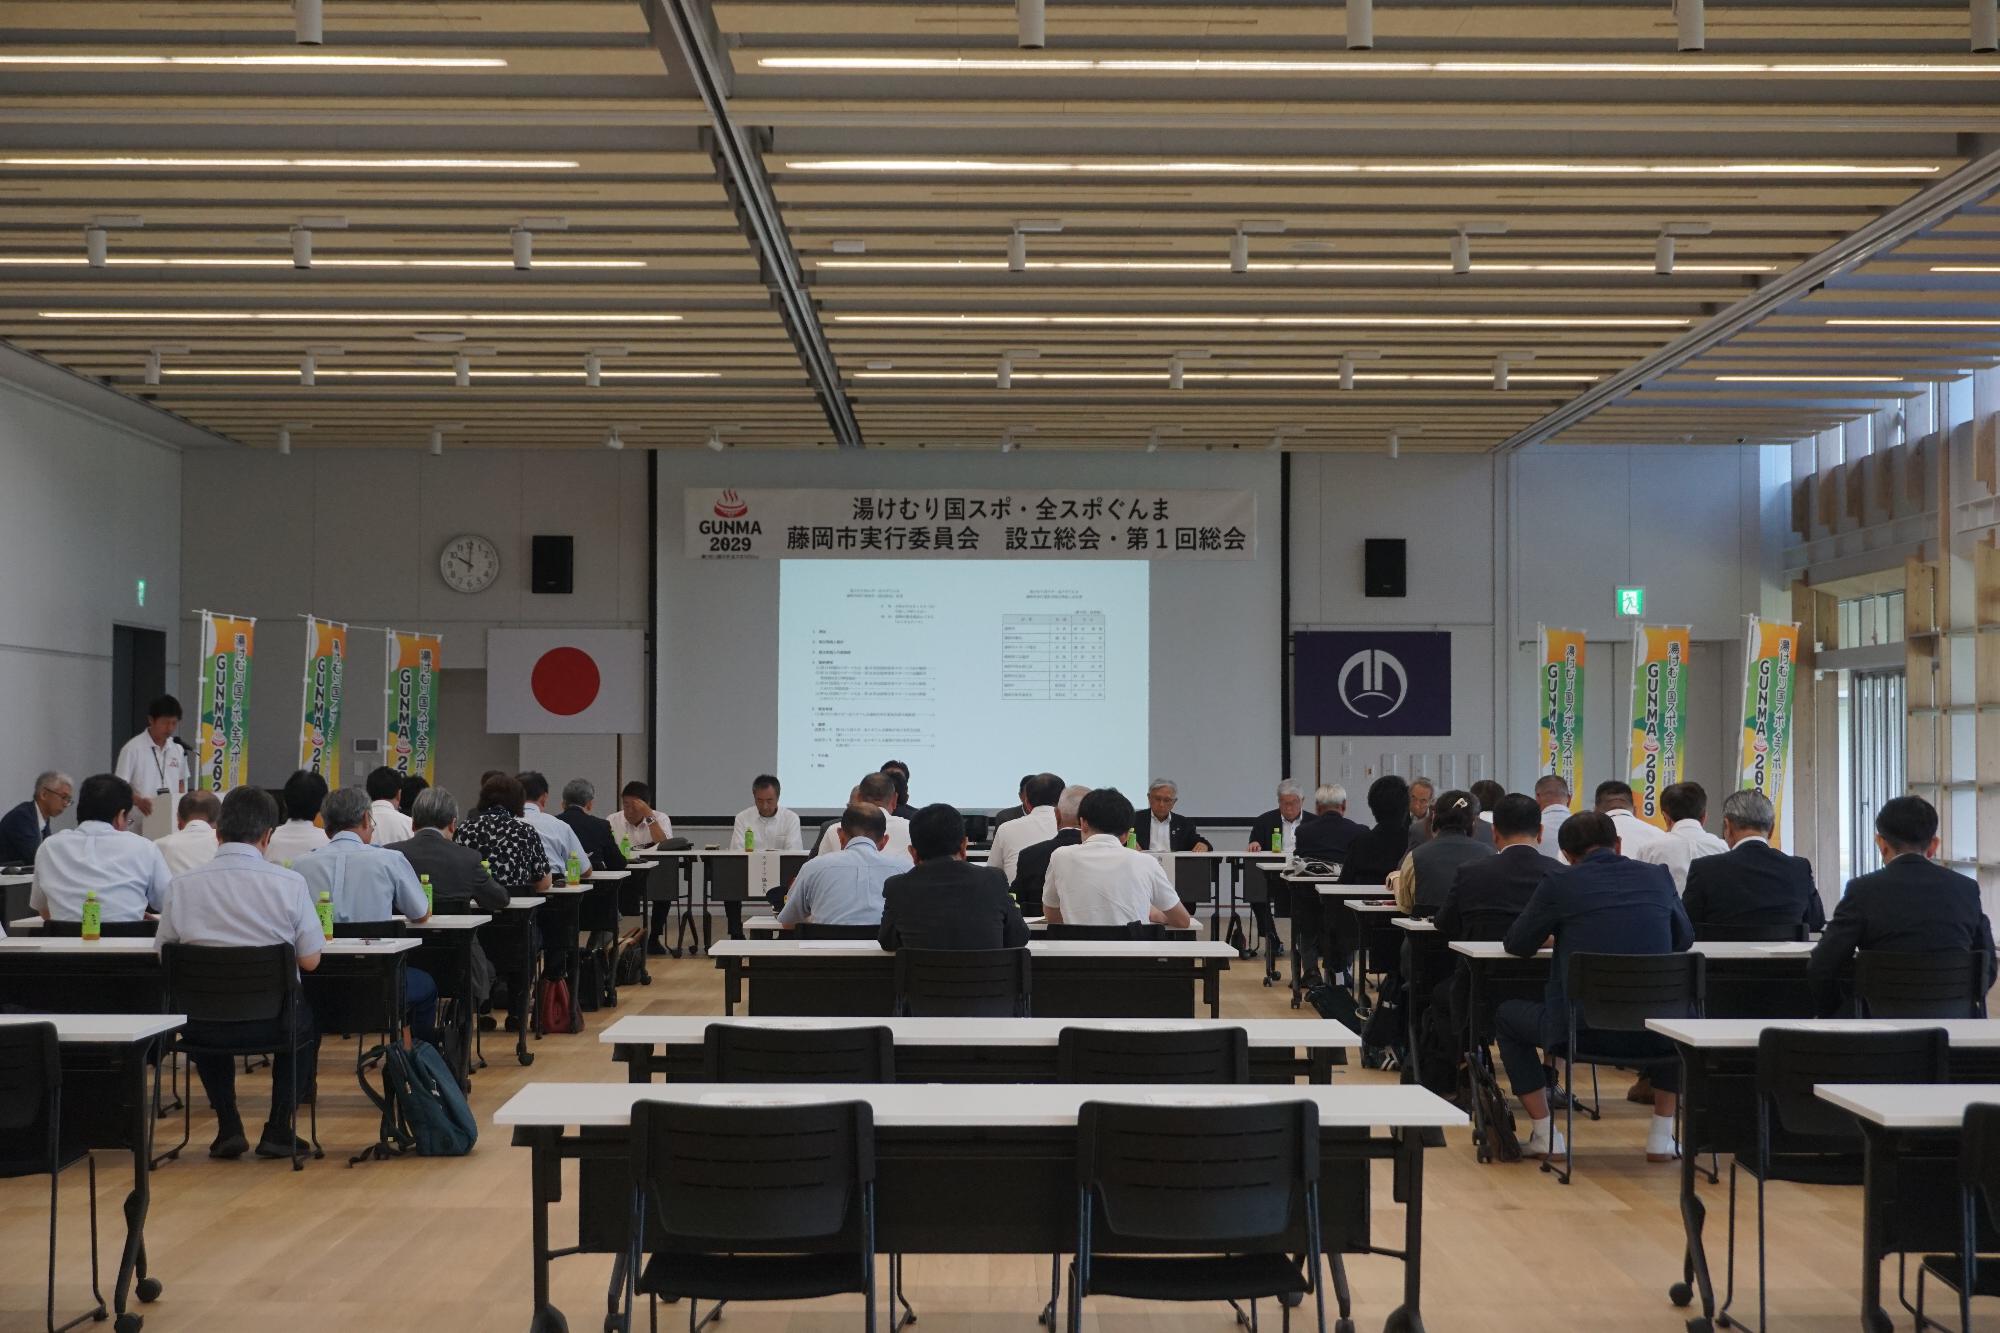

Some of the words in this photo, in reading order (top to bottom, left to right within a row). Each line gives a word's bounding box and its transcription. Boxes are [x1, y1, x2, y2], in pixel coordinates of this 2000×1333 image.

[699, 520, 762, 535] GUNMA
[787, 526, 980, 550] 藤岡市実行委員会
[1005, 526, 1246, 550] 設立総会・第1回総会
[852, 496, 1169, 521] 湯けむり国スポ・全スポぐんま
[710, 537, 752, 552] 2029
[214, 655, 226, 730] GUNMA
[314, 658, 325, 731] GUNMA
[398, 669, 410, 739] GUNMA
[1548, 664, 1558, 735] GUNMA
[1646, 663, 1659, 736] GUNMA
[1756, 660, 1769, 736] GUNMA
[1644, 753, 1656, 817] 2029
